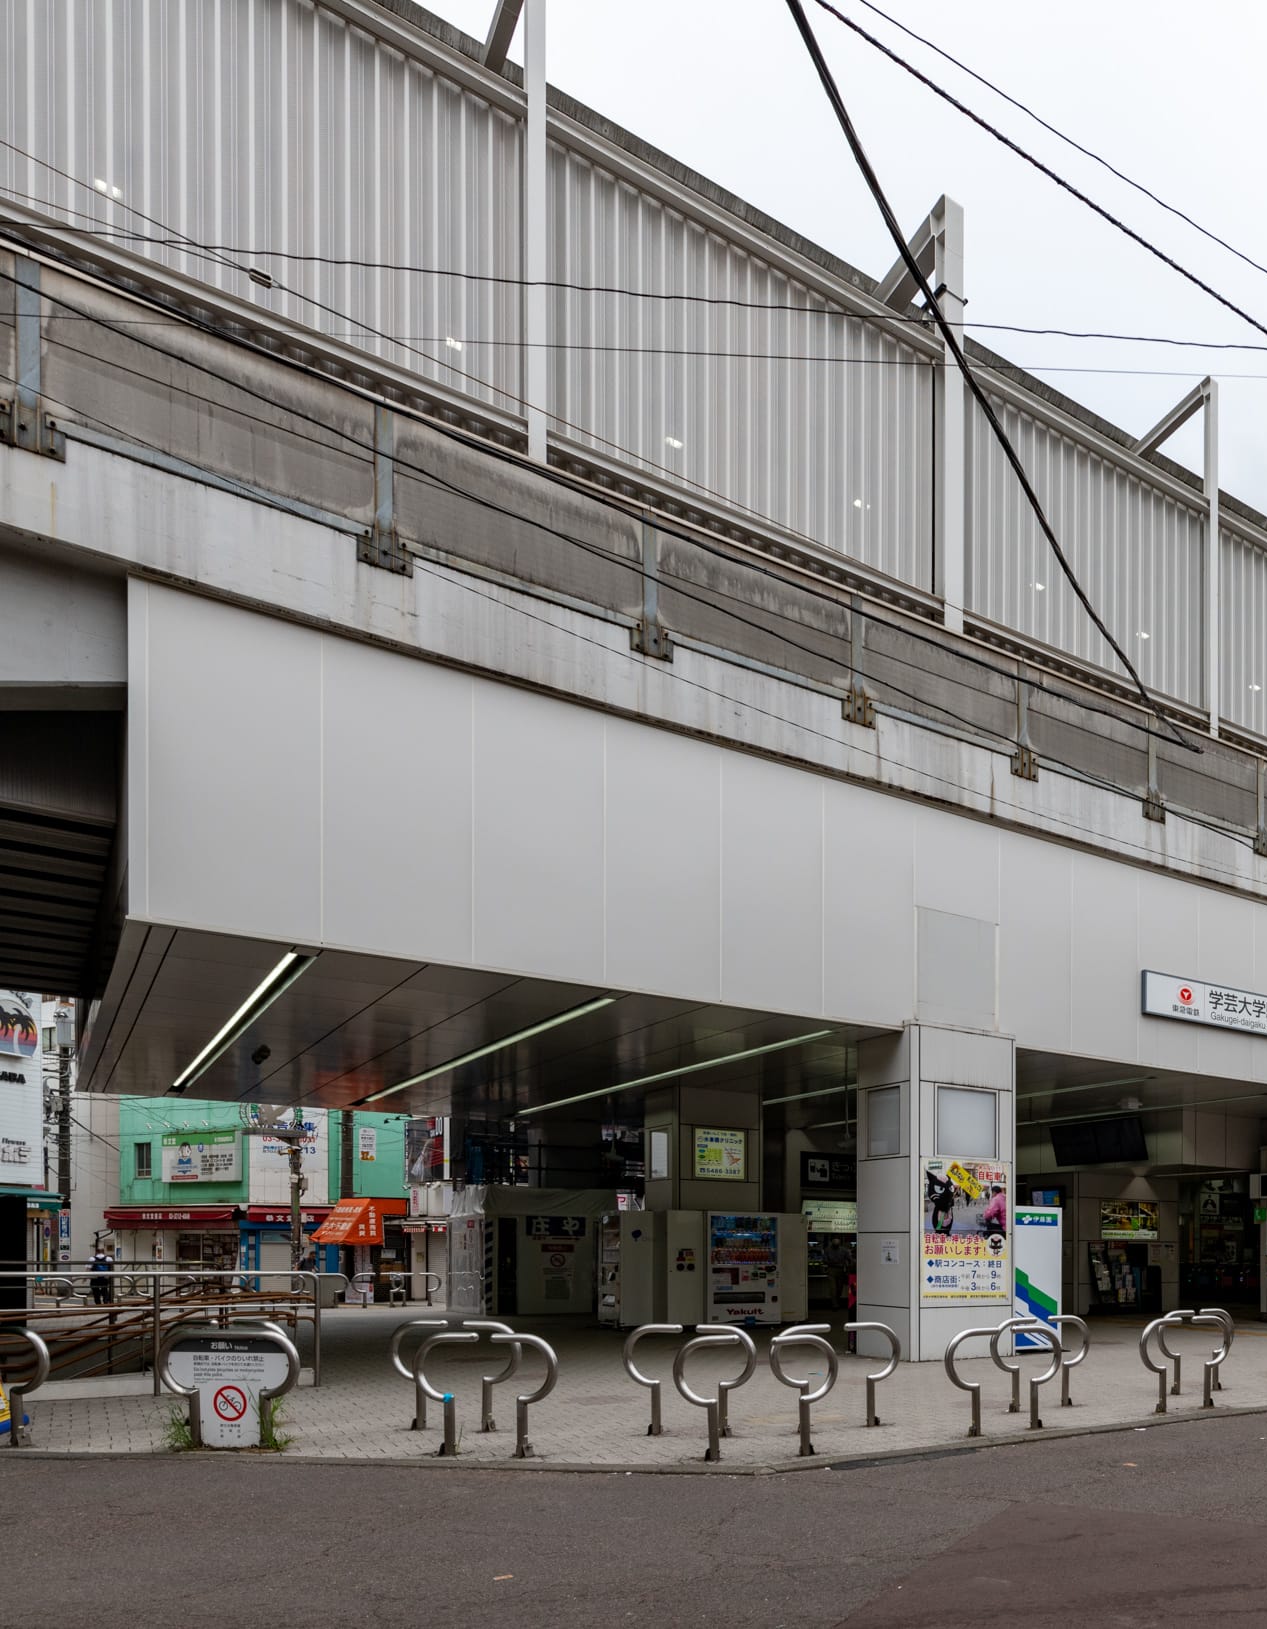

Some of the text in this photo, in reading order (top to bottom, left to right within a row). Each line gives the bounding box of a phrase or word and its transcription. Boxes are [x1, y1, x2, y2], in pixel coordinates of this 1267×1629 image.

[1172, 1004, 1200, 1017] 東急電鉄
[1210, 1011, 1266, 1030] Gakugei-daigaku
[1032, 1215, 1053, 1224] 伊藤園
[530, 1217, 580, 1236] 庄や
[726, 1307, 765, 1317] Yakult
[210, 1341, 233, 1350] お願い
[192, 1354, 265, 1362] 自転車・バイクのりいれ禁止
